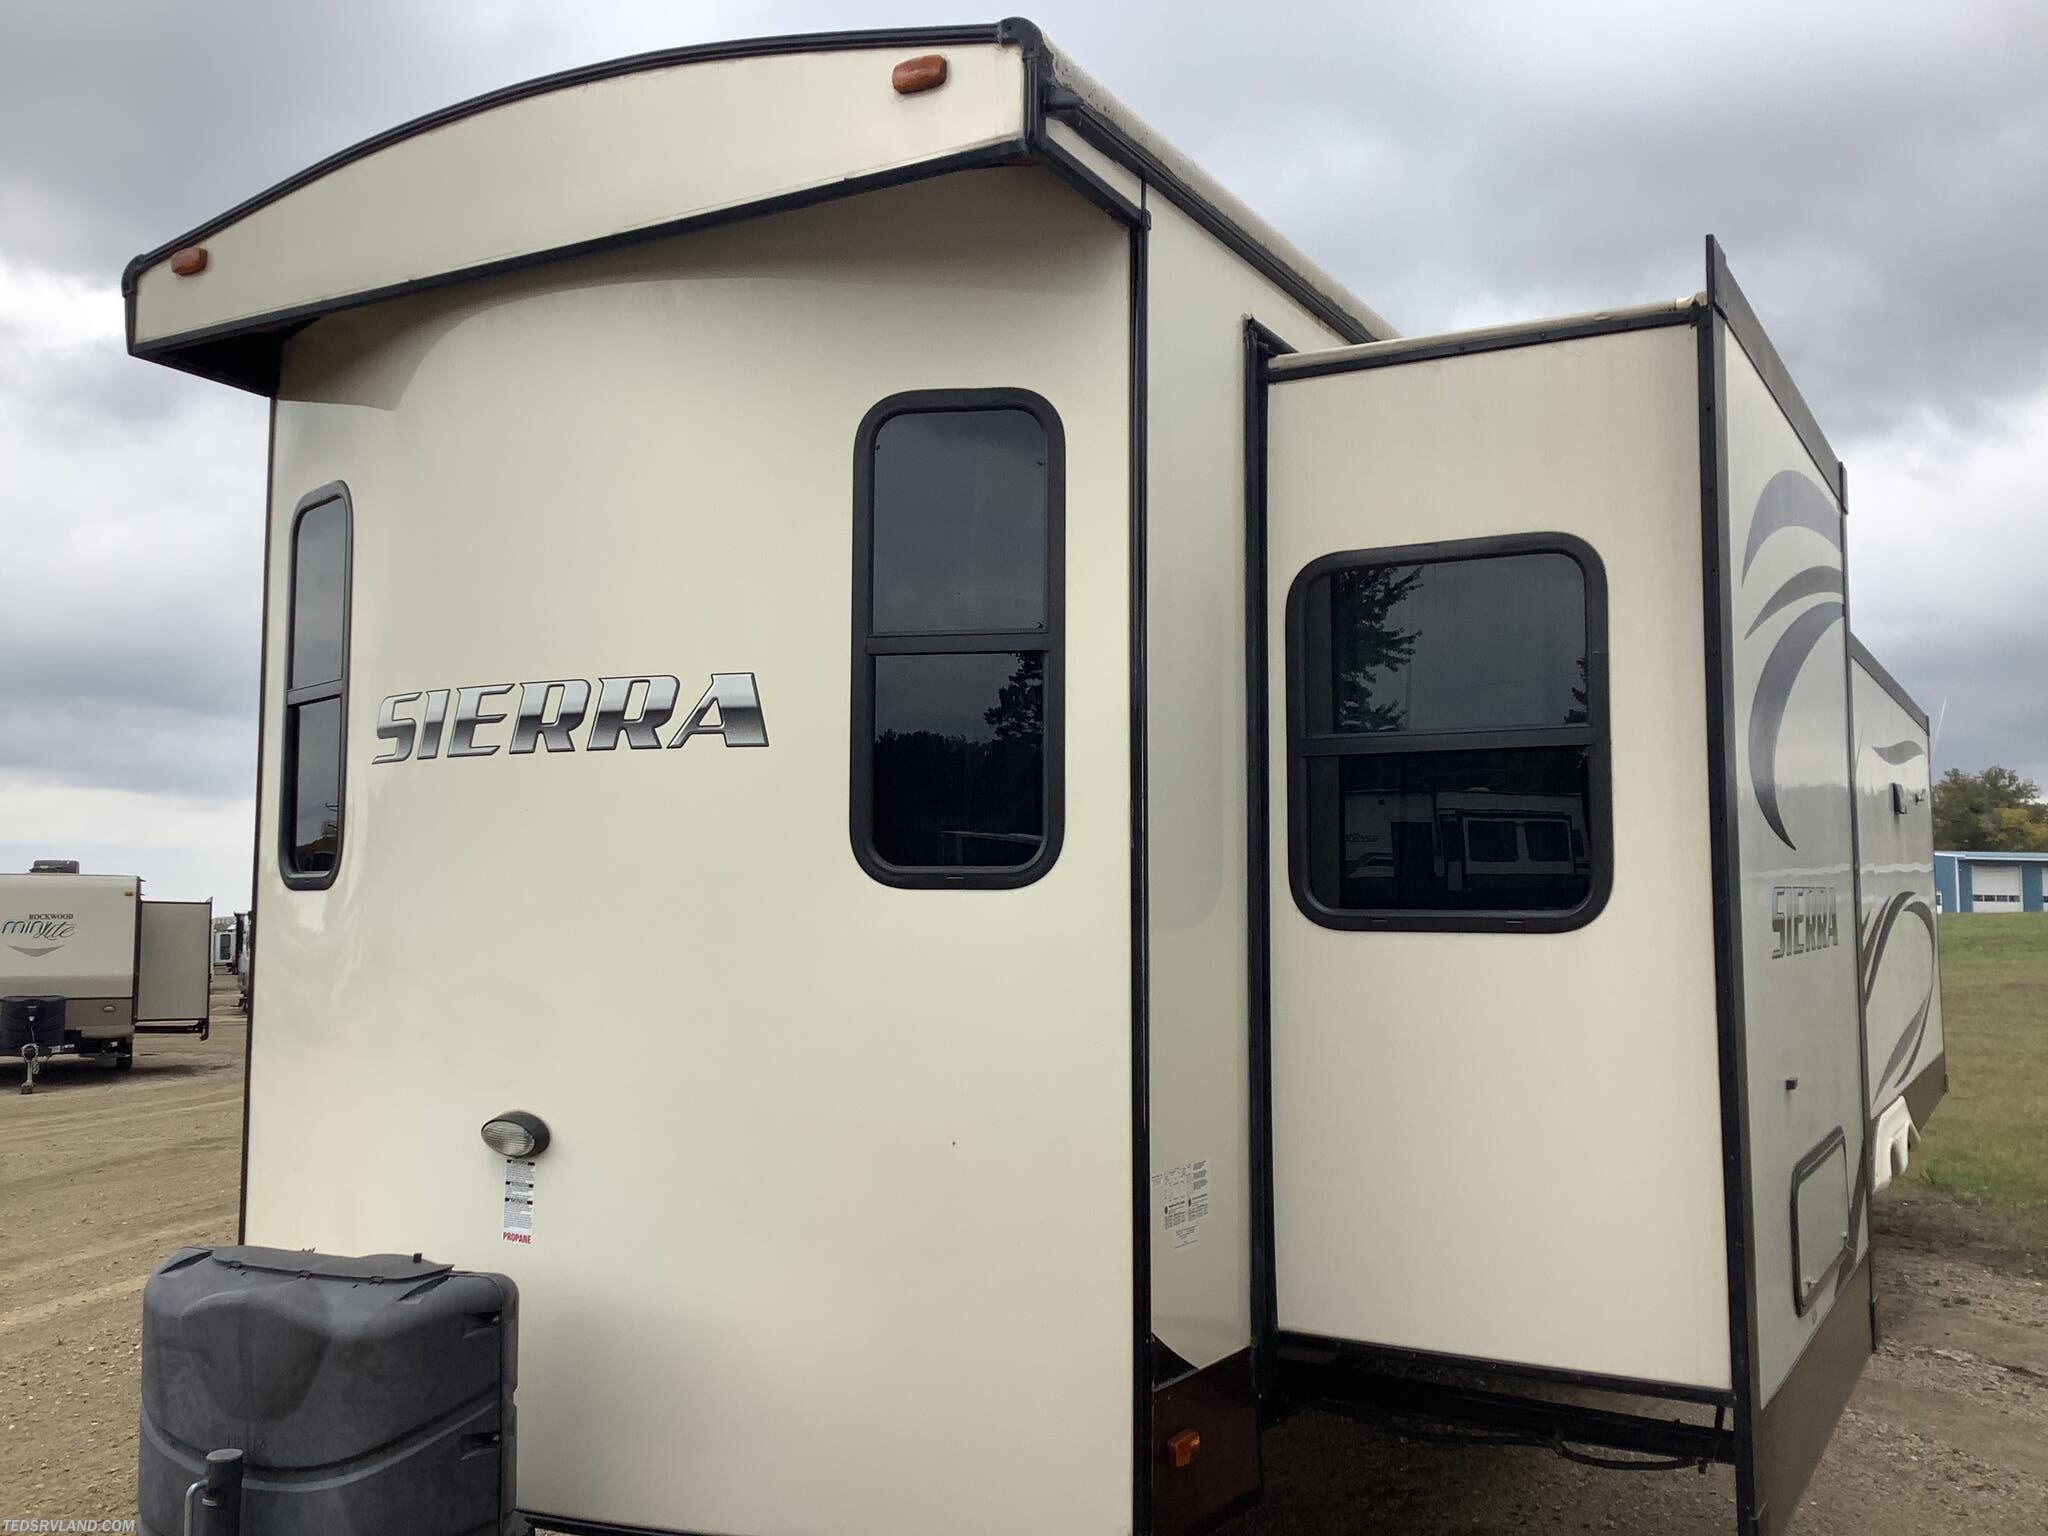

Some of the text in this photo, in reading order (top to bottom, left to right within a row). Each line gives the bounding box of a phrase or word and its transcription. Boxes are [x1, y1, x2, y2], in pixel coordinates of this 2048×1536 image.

[372, 673, 769, 765] SIERRA
[1771, 886, 1838, 960] SIERRA
[502, 1231, 532, 1244] PROPANE
